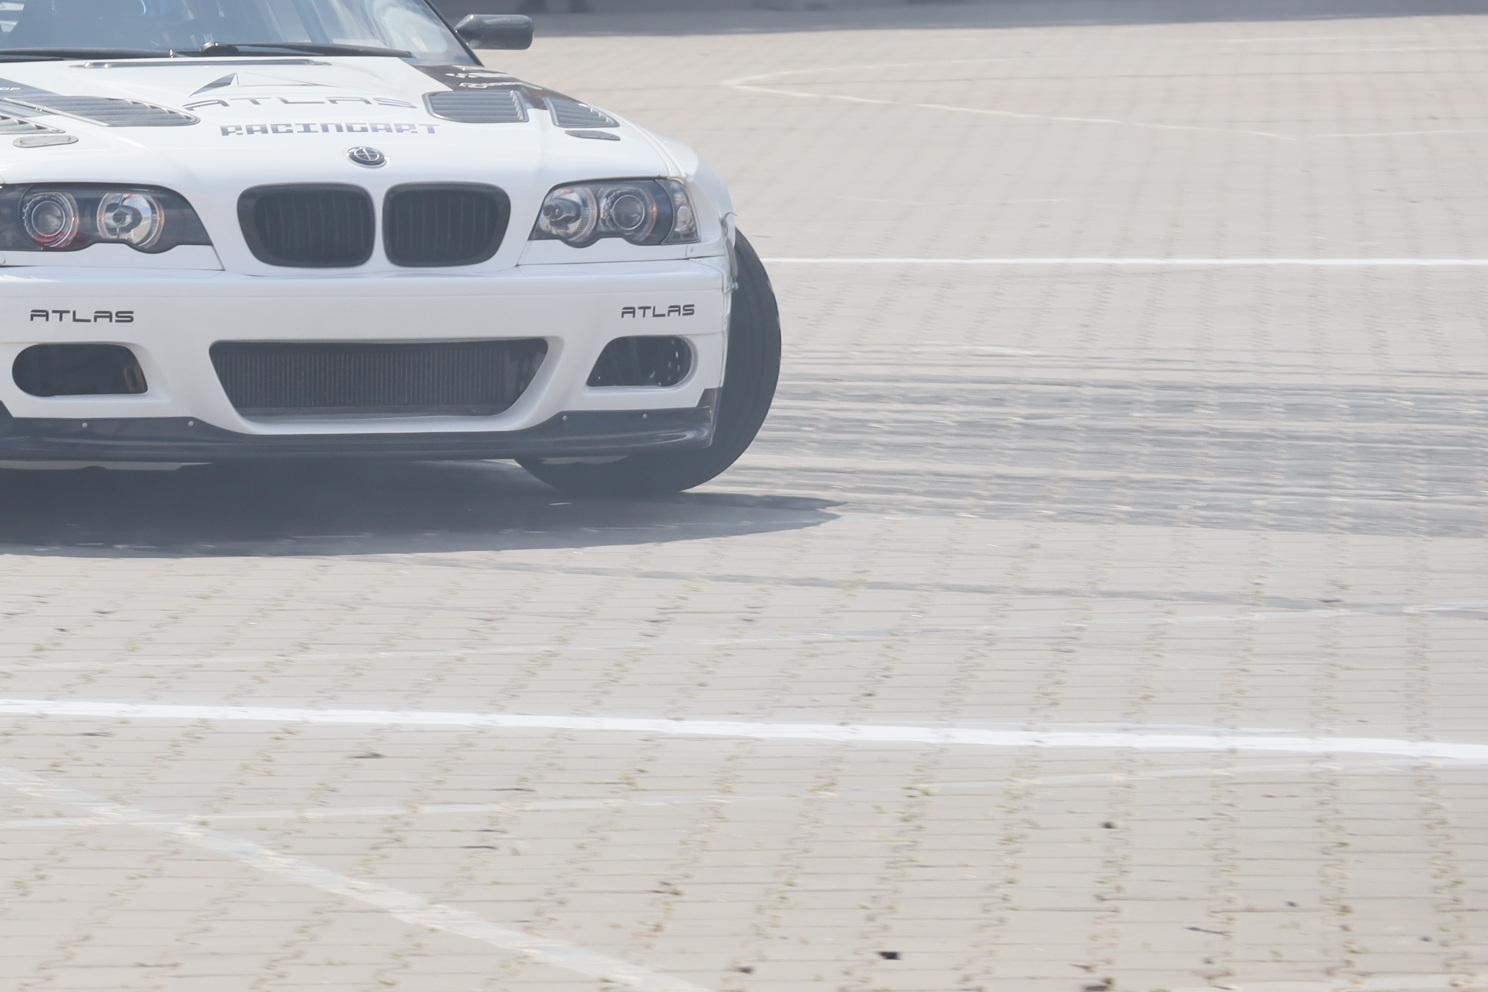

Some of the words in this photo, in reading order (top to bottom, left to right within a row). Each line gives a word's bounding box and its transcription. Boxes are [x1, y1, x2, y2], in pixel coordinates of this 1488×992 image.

[182, 96, 418, 112] ATLAS
[30, 309, 134, 323] ATLAS
[621, 304, 695, 318] ATLAS
